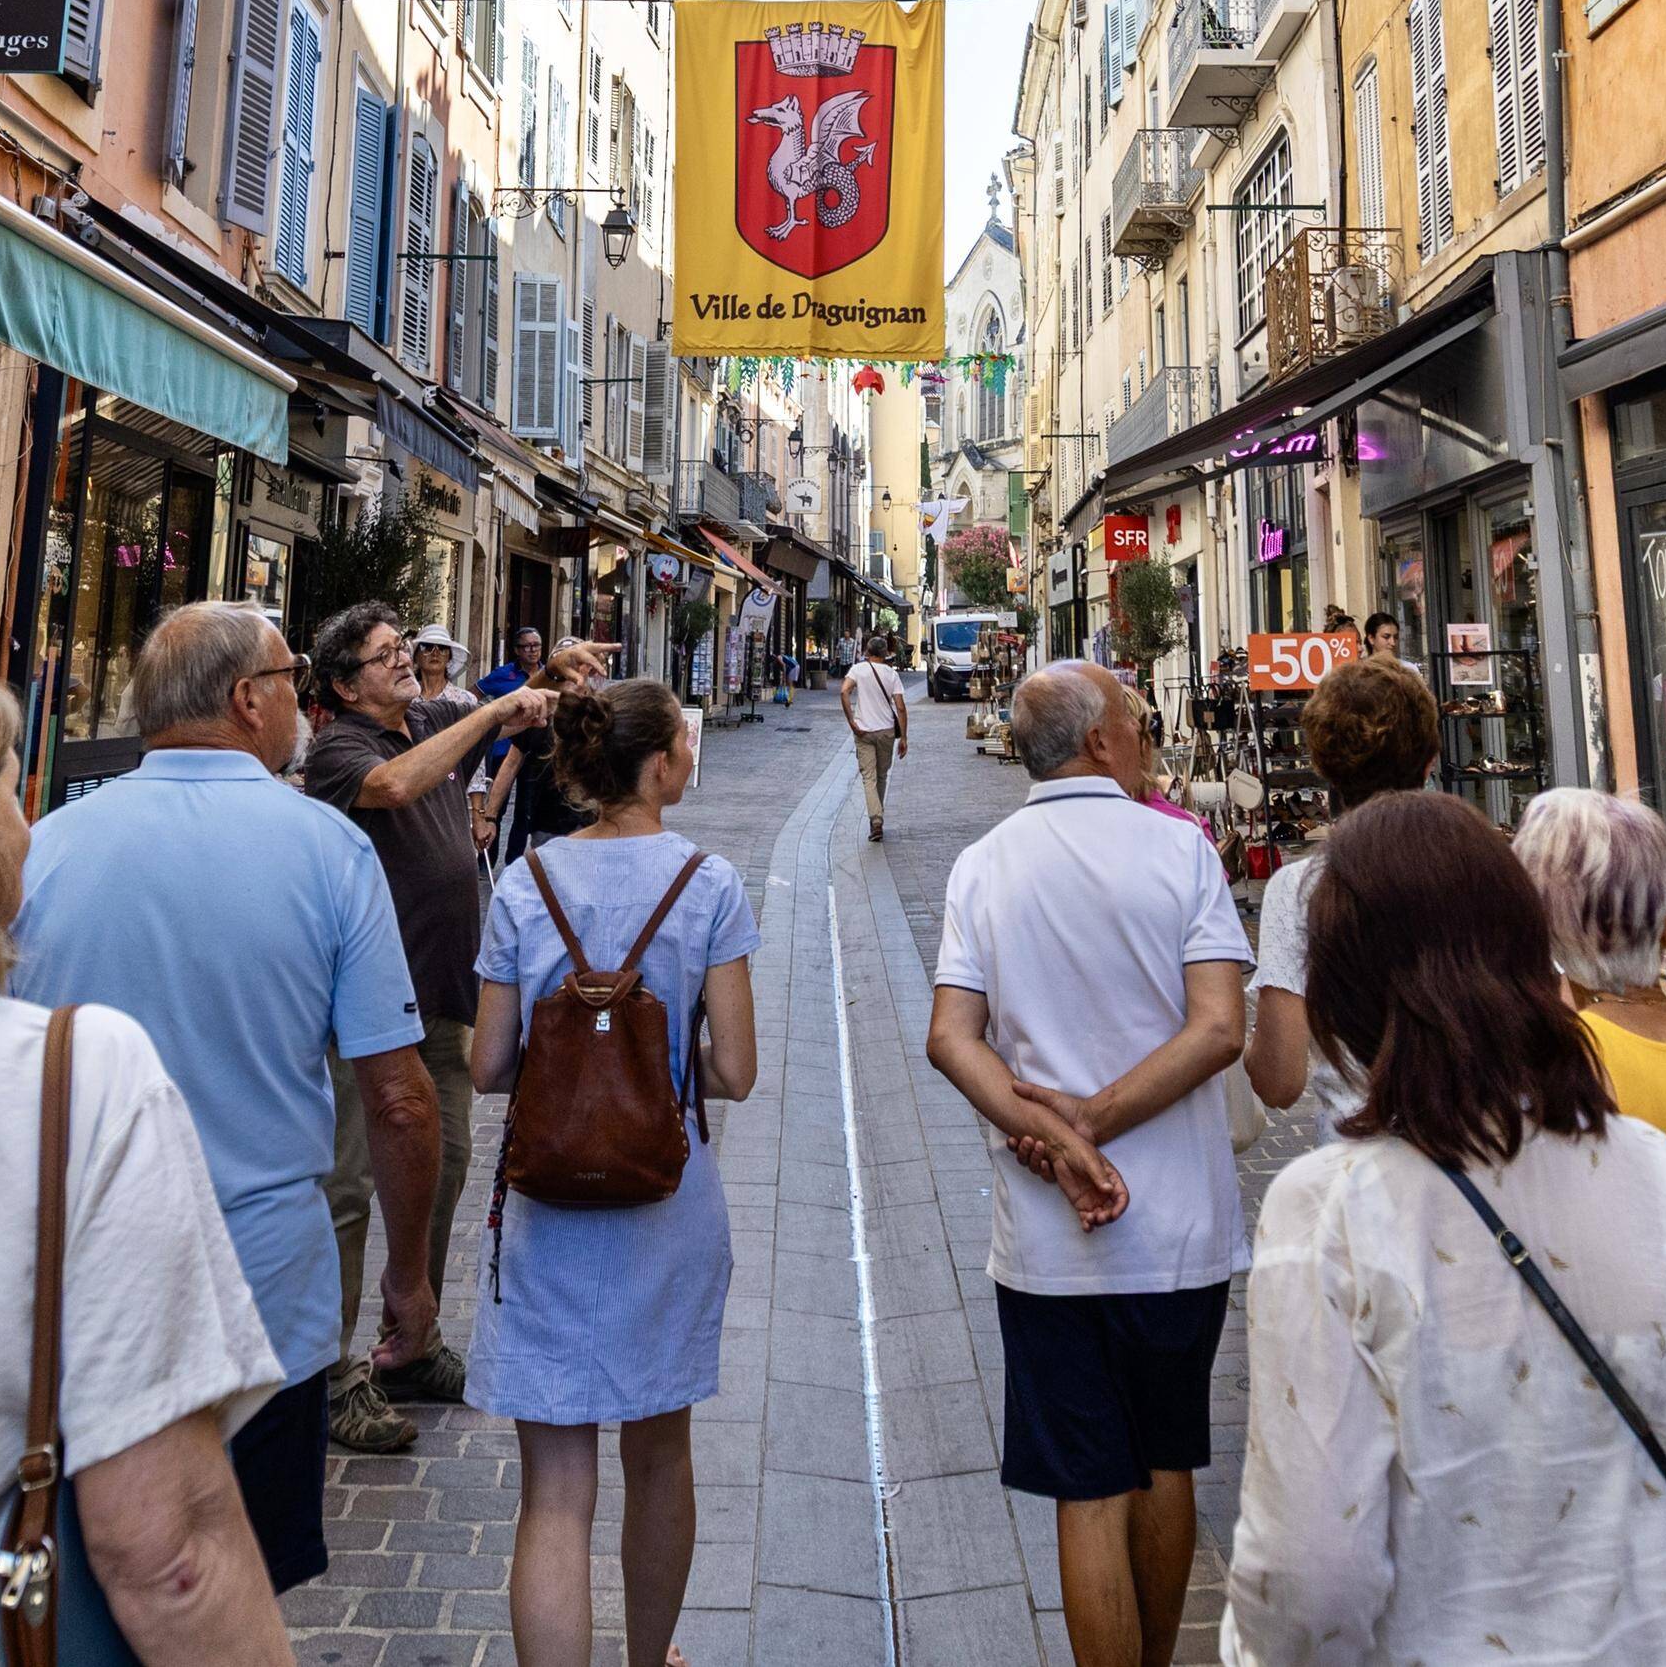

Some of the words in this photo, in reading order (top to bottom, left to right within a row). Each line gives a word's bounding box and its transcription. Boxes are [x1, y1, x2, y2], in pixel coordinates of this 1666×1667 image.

[689, 293, 751, 321] Ville
[756, 293, 787, 320] de
[791, 291, 927, 329] Draguignan
[1114, 529, 1147, 546] SFR
